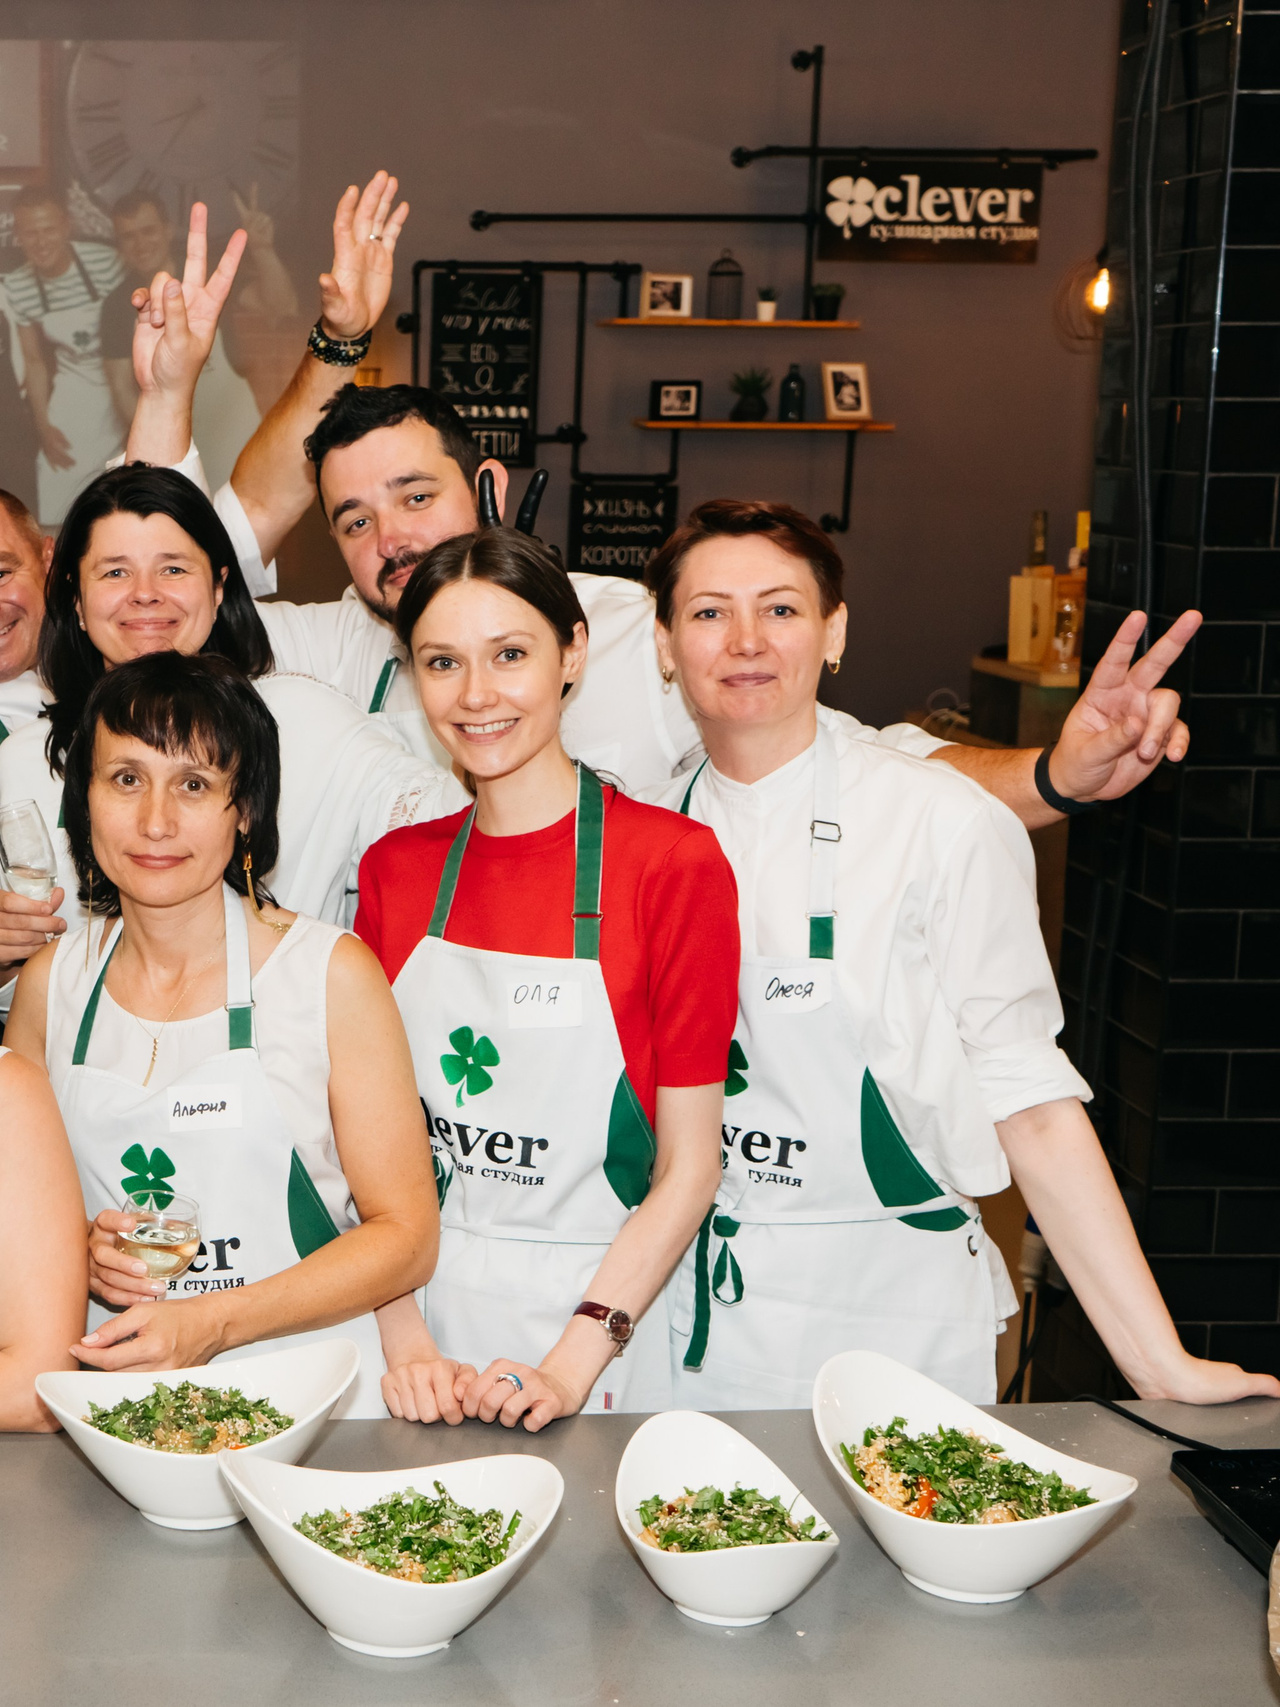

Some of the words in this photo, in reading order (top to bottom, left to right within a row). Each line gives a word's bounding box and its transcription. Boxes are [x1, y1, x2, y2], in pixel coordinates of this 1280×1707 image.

[872, 174, 1035, 223] clever
[765, 976, 814, 1001] Олеся
[419, 1095, 549, 1169] lever
[721, 1123, 807, 1169] ver
[480, 1167, 545, 1186] студия
[748, 1168, 803, 1188] тудия
[183, 1277, 245, 1294] студия
